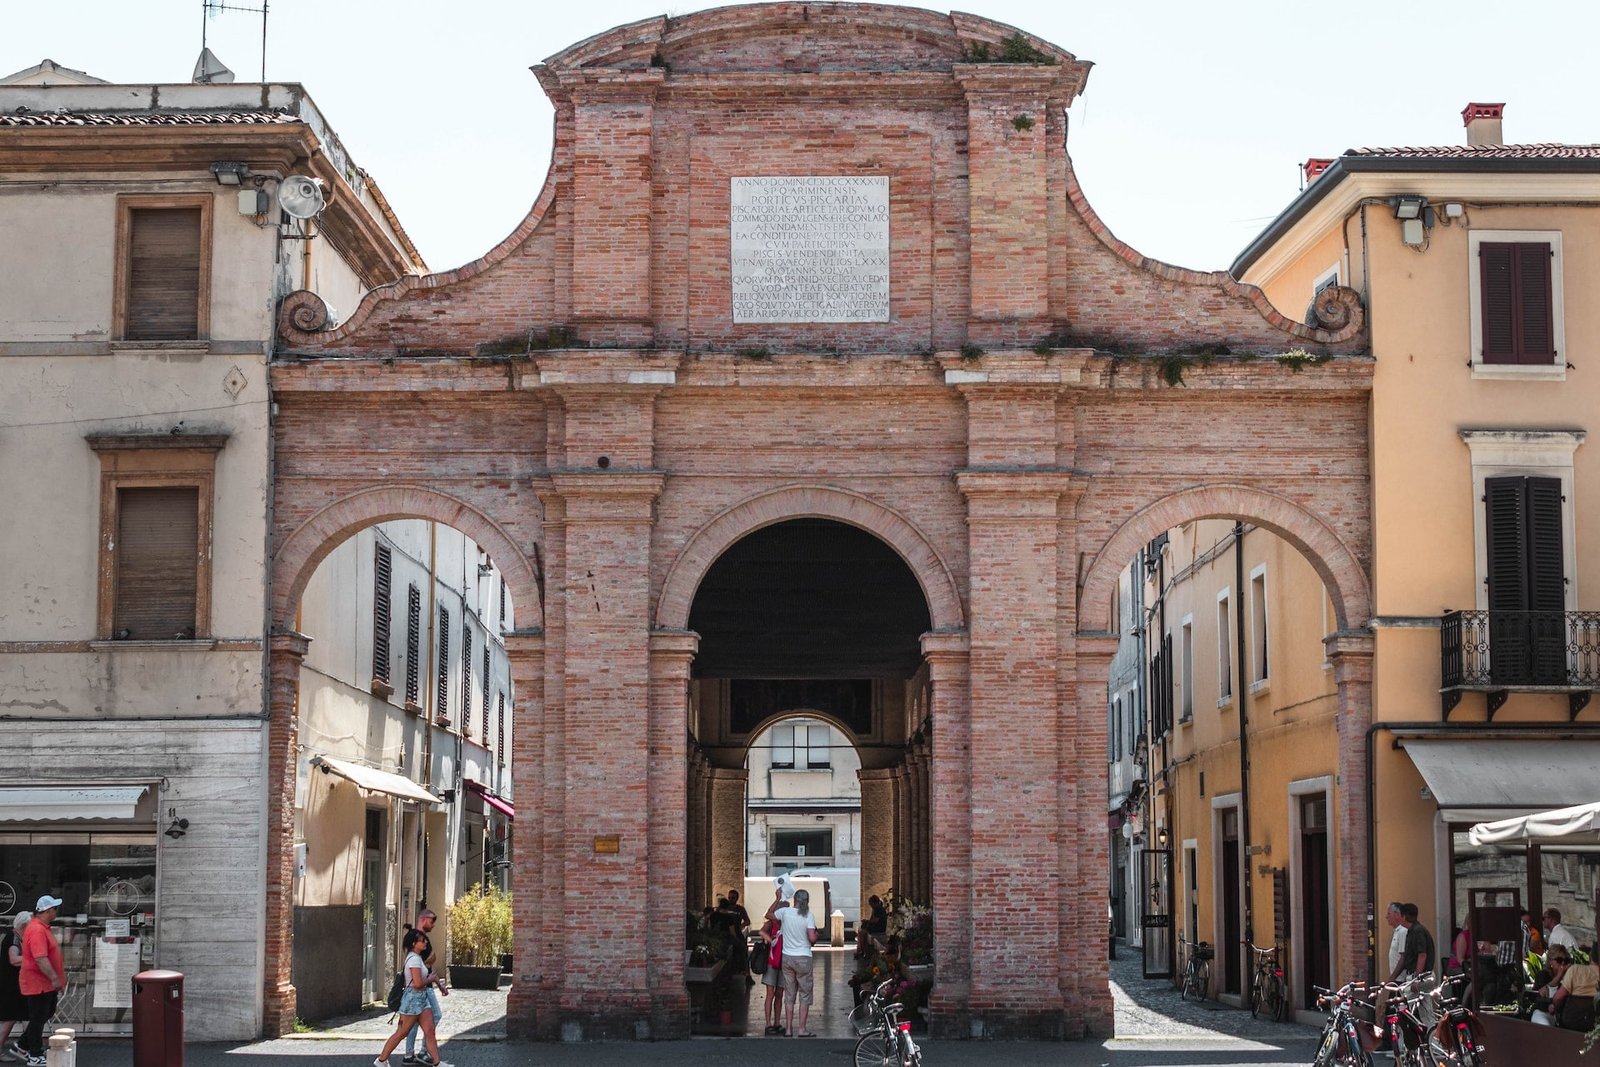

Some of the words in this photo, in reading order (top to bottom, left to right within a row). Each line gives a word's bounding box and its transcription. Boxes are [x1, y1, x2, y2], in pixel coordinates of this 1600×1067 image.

[737, 178, 767, 186] ANNO
[770, 178, 805, 186] DOMINI
[790, 187, 857, 195] ARIMINENSIS
[751, 196, 807, 205] PORTICVS
[810, 195, 869, 205] PISCARIAS
[732, 205, 791, 214] PISCATORIAE
[731, 214, 780, 223] COMMODO
[764, 223, 831, 231] FVNDAMENTIS
[833, 223, 866, 231] EREXIT
[735, 232, 748, 240] EA
[750, 232, 812, 240] CONDITIONE
[765, 241, 789, 249] CVM
[792, 241, 856, 249] PARTICIPIBVS
[753, 250, 783, 258] PISCIS
[785, 250, 837, 258] VENDENDI
[819, 258, 852, 266] IVLIOS
[855, 257, 886, 266] LXXX
[819, 267, 855, 275] SOLVAT
[733, 276, 772, 285] QVORVM
[752, 284, 782, 293] QVOD
[784, 284, 816, 292] ANTEA
[733, 292, 780, 301] RELIQVVM
[733, 301, 754, 310] QVO
[755, 302, 791, 310] SOLVTO
[736, 310, 779, 318] AERARIO
[781, 310, 820, 318] PVBLICO
[168, 807, 176, 817] 11
